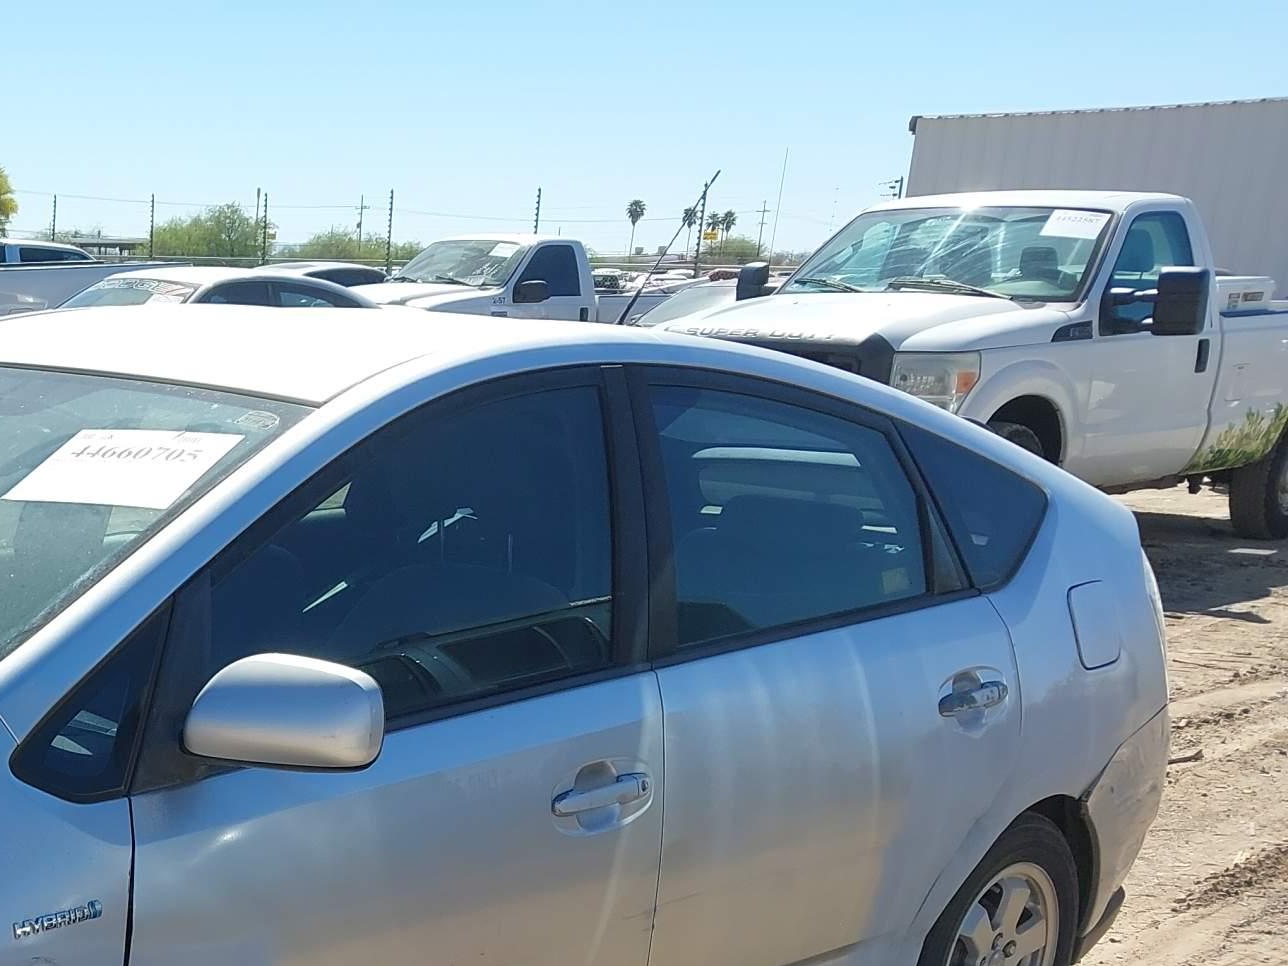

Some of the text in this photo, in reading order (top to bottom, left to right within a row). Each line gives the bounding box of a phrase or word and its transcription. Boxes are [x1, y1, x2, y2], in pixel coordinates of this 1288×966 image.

[686, 327, 759, 337] SUPER
[71, 445, 204, 462] 44660705
[13, 906, 89, 939] HYBRID
